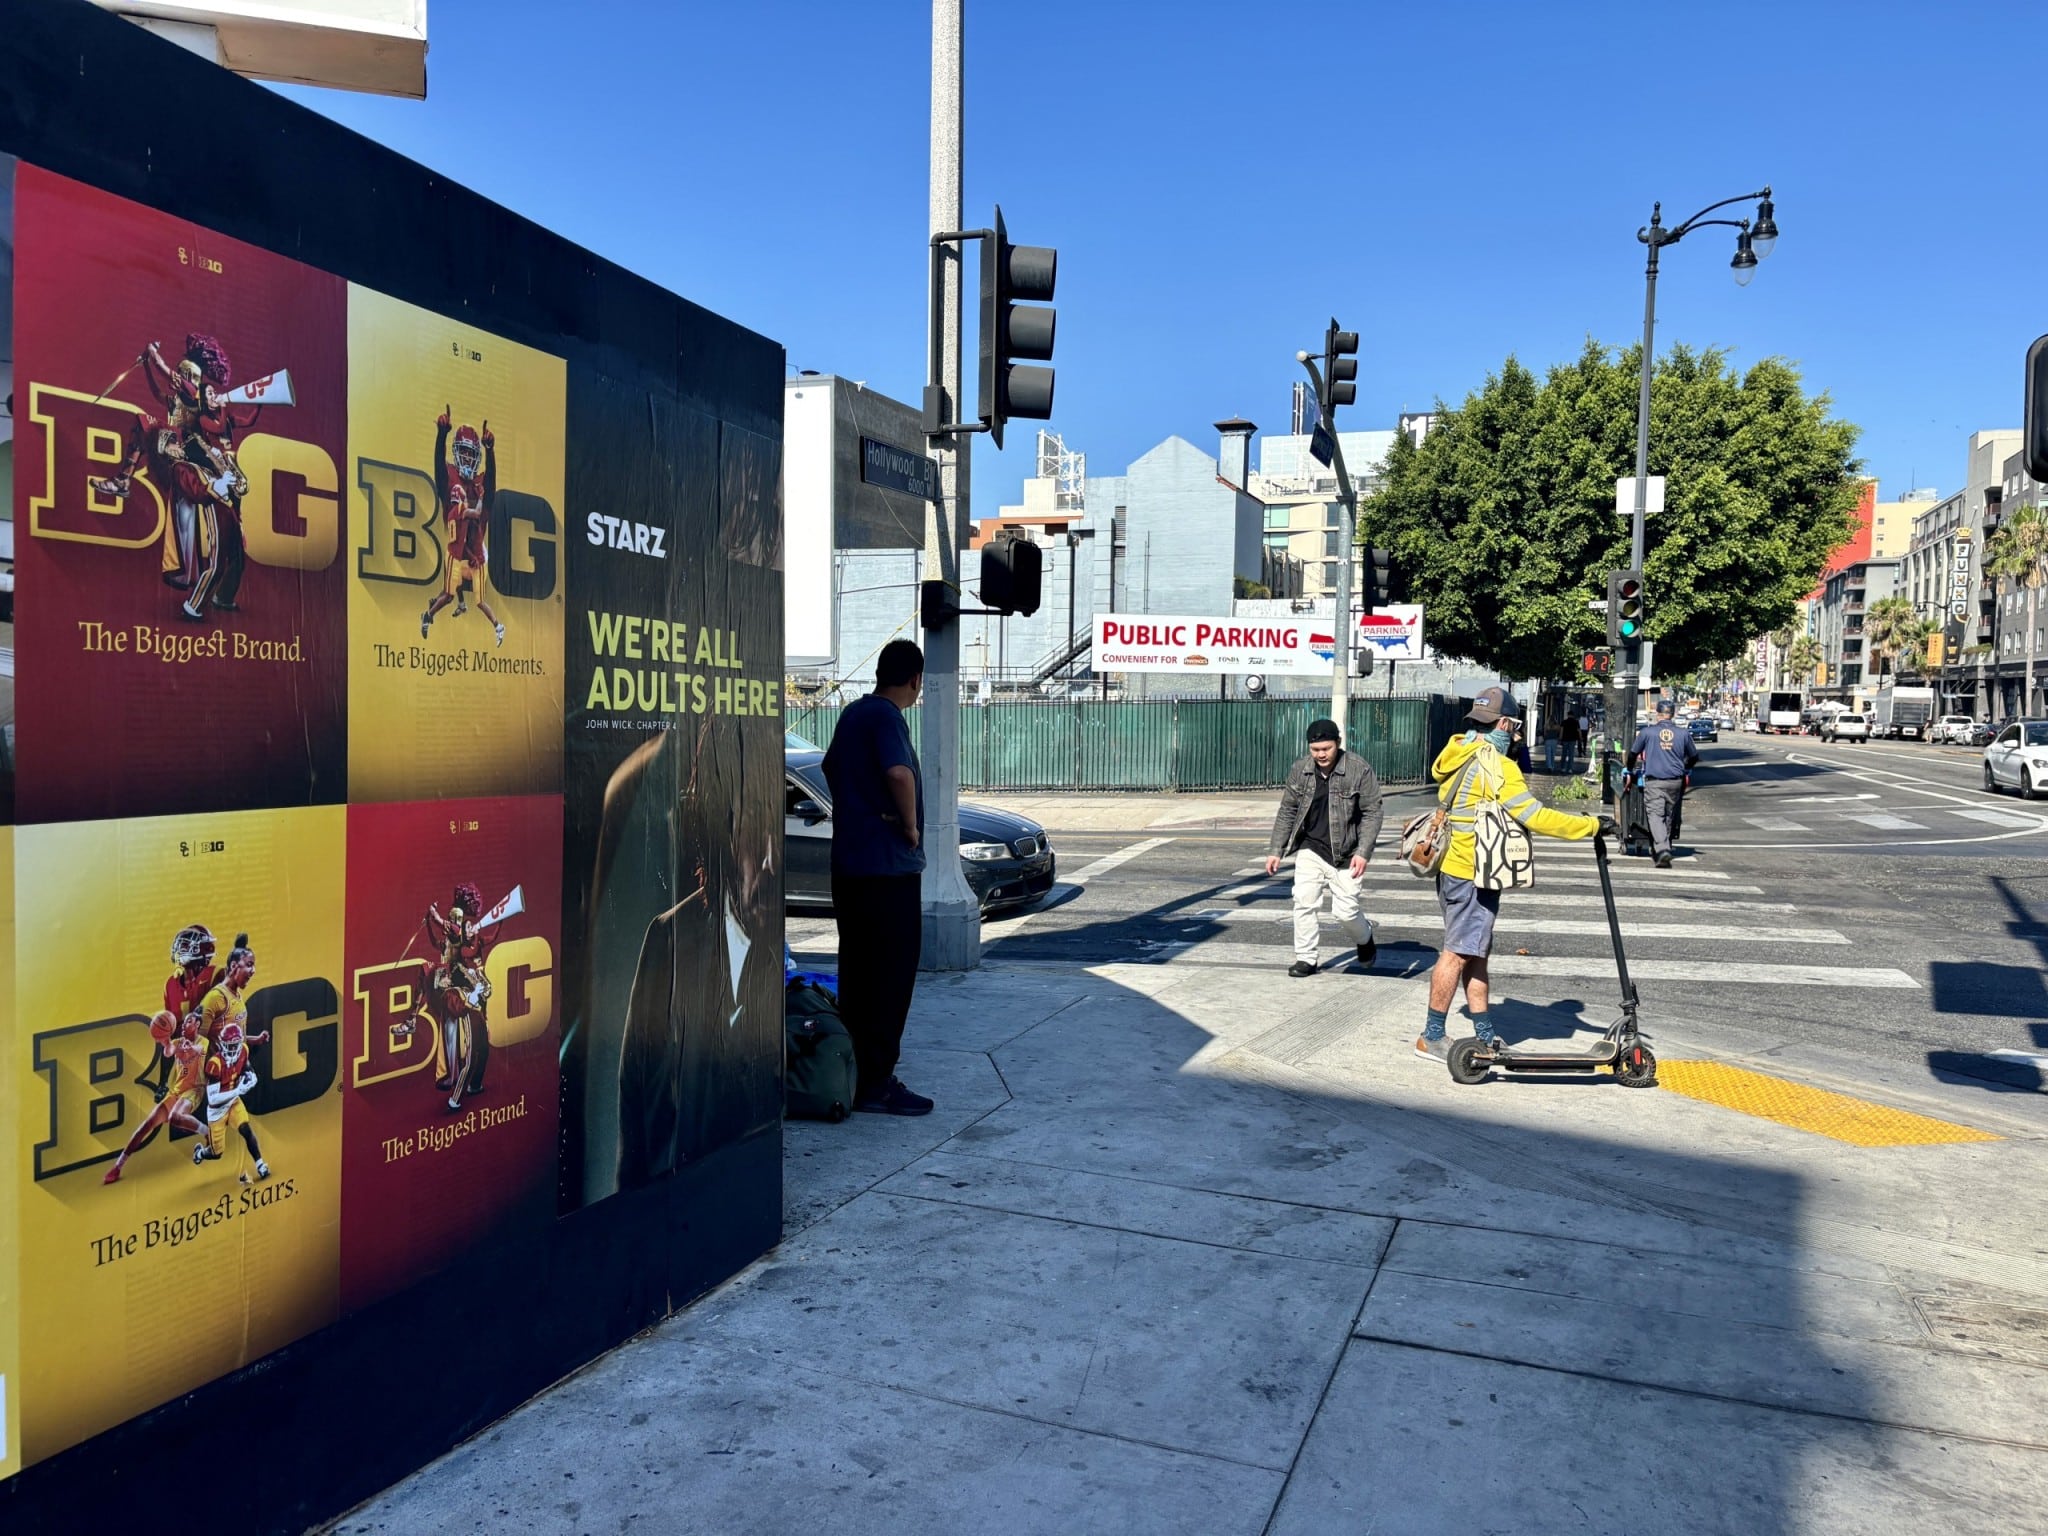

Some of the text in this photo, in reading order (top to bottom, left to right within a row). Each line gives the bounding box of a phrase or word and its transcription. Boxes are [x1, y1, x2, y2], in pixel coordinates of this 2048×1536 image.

[868, 441, 915, 476] Hollywood
[908, 478, 924, 495] 6000
[586, 511, 666, 558] STARZ
[78, 621, 306, 663] The Biggest Brand.
[587, 610, 743, 669] WE'RE ALL
[1102, 621, 1298, 649] PUBLIC PARKING
[1363, 626, 1407, 635] PARKING
[373, 644, 546, 677] The Biggest Moments.
[1102, 653, 1159, 664] CONVENIENT
[1600, 656, 1609, 671] 2
[585, 666, 779, 717] ADULTS HERE
[585, 719, 678, 731] JOHN WICK: CHAPTER 4
[382, 1095, 528, 1163] The Biggest Brand.
[91, 1178, 299, 1268] The Biggest Stars.
